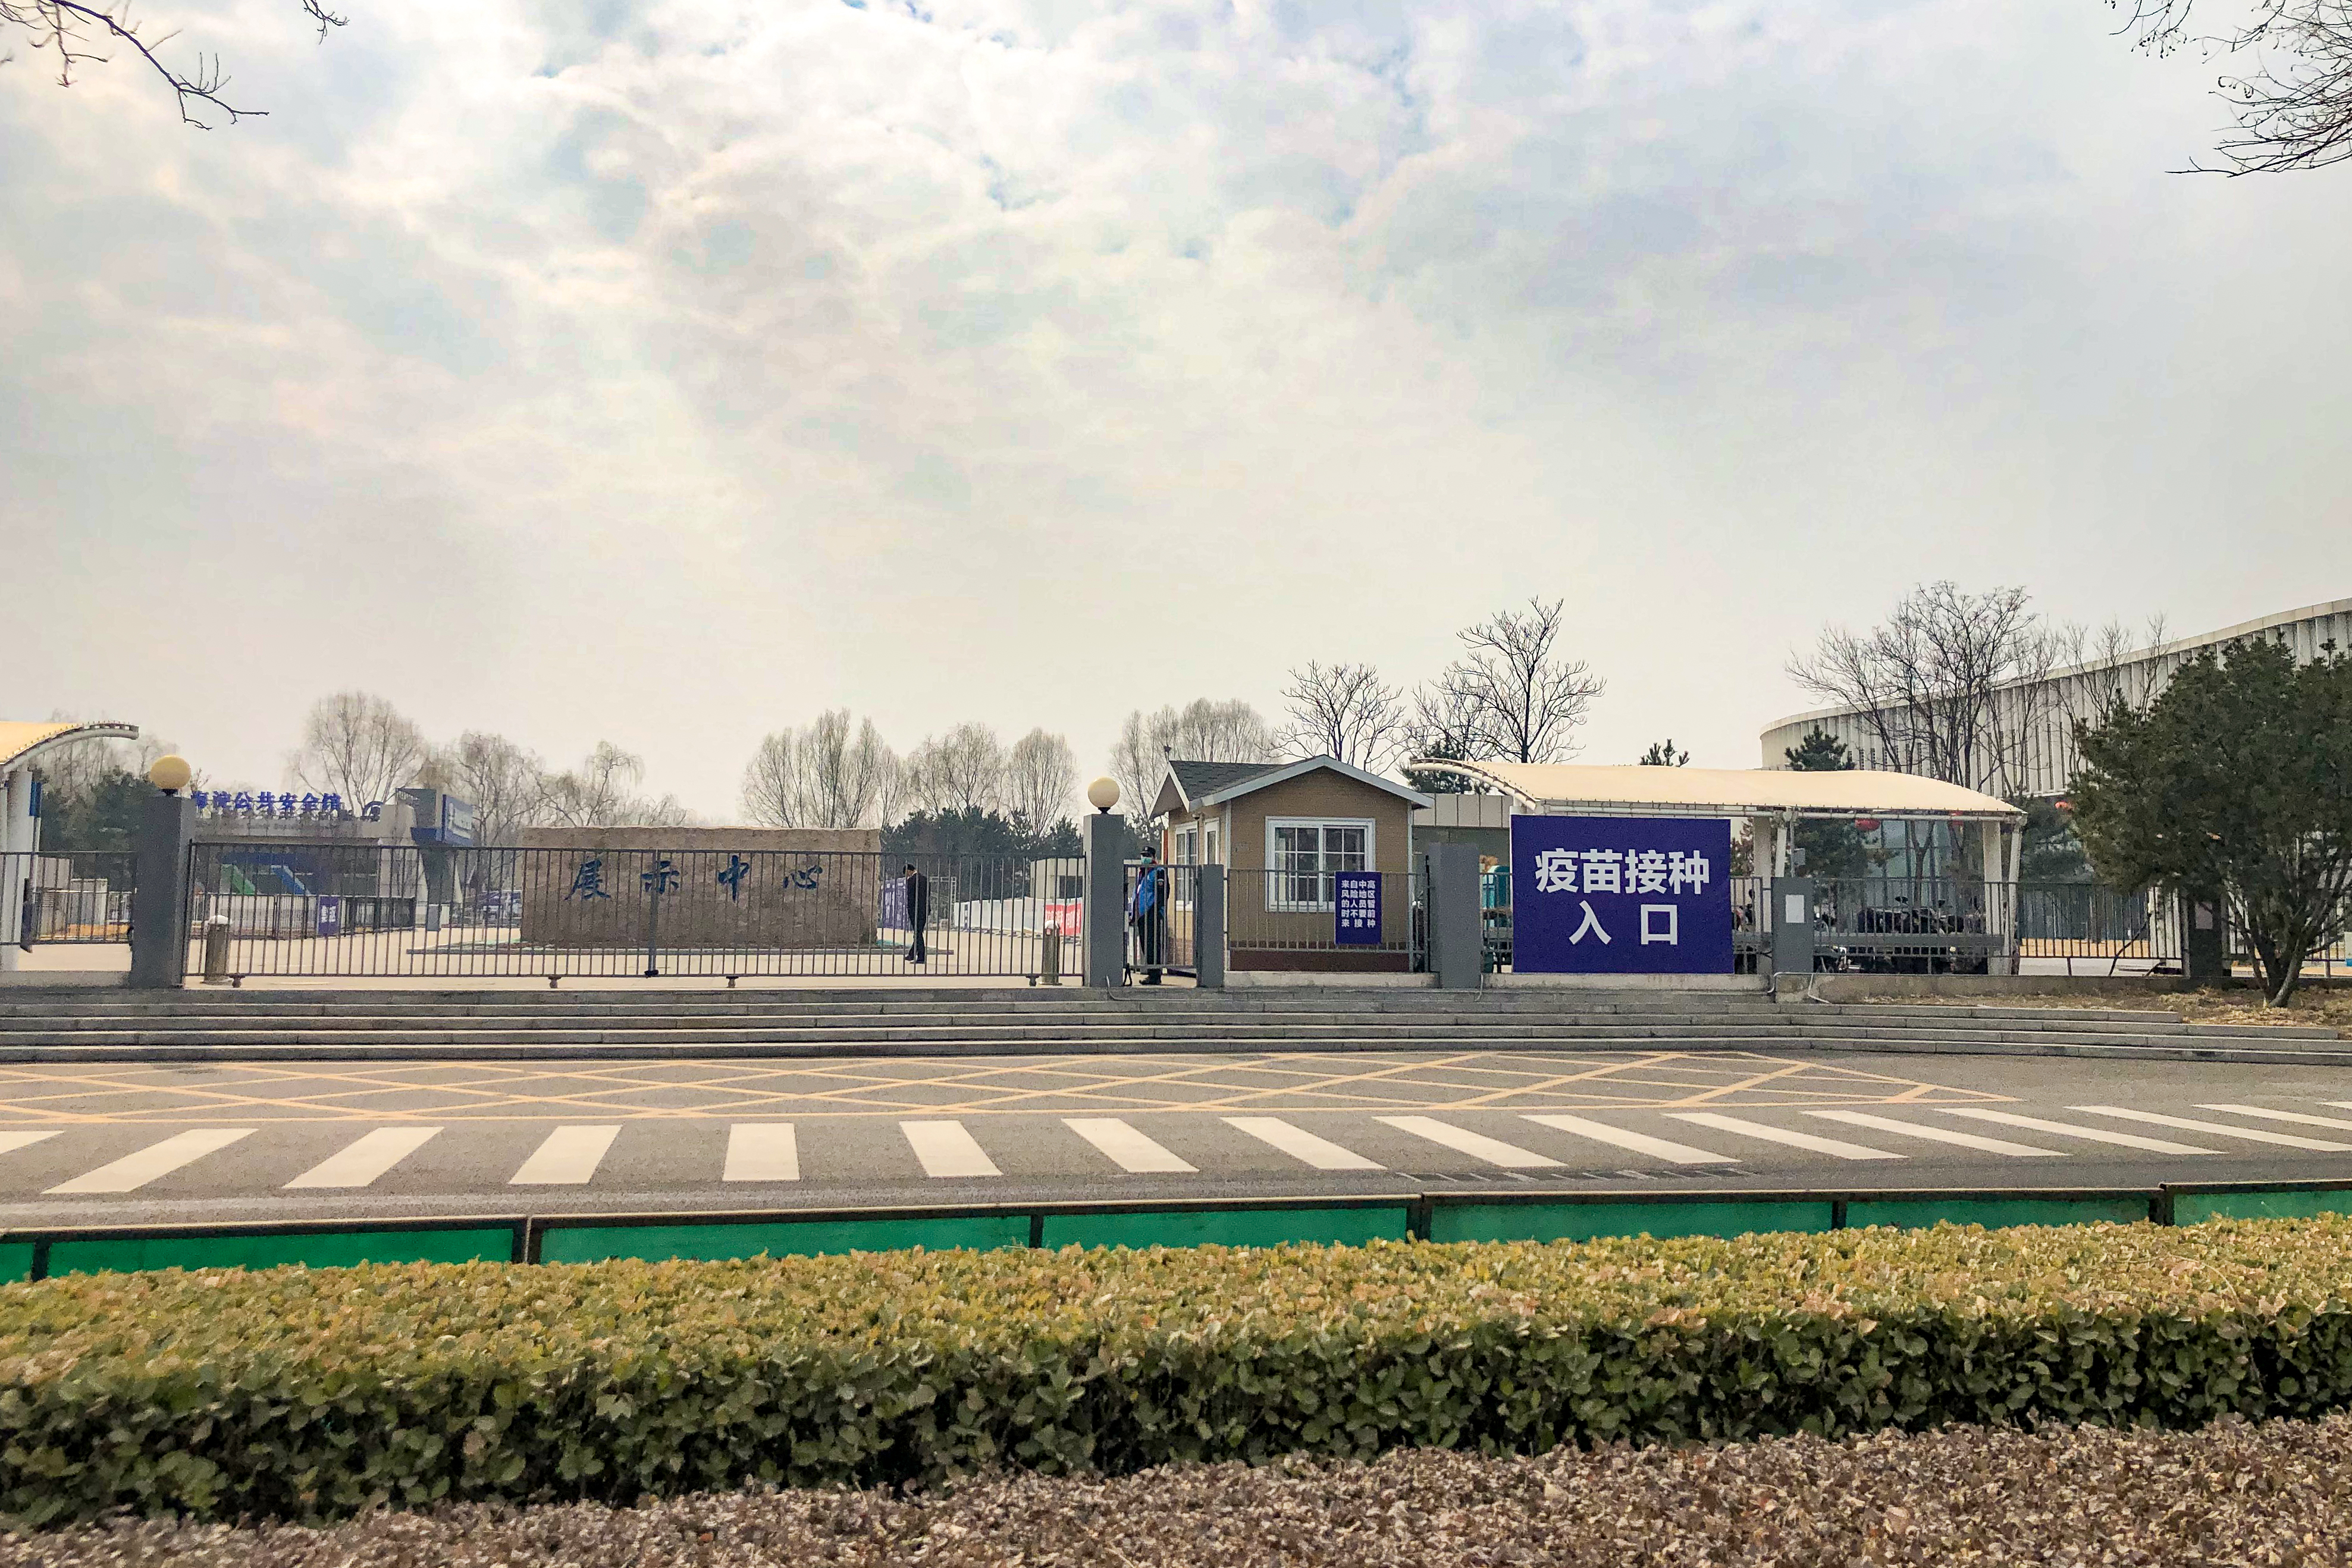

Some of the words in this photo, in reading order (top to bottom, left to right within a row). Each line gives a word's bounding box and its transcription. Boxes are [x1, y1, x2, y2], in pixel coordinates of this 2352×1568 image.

[1535, 848, 1709, 894] 疫苗接种
[565, 855, 823, 902] 展示中心
[1341, 880, 1375, 889] 来自中高
[1341, 889, 1375, 898] 风险地区
[1341, 899, 1375, 908] 的人员暂
[1341, 909, 1375, 918] 时不要前
[1341, 918, 1376, 928] 来接种
[1569, 900, 1677, 945] 入口
